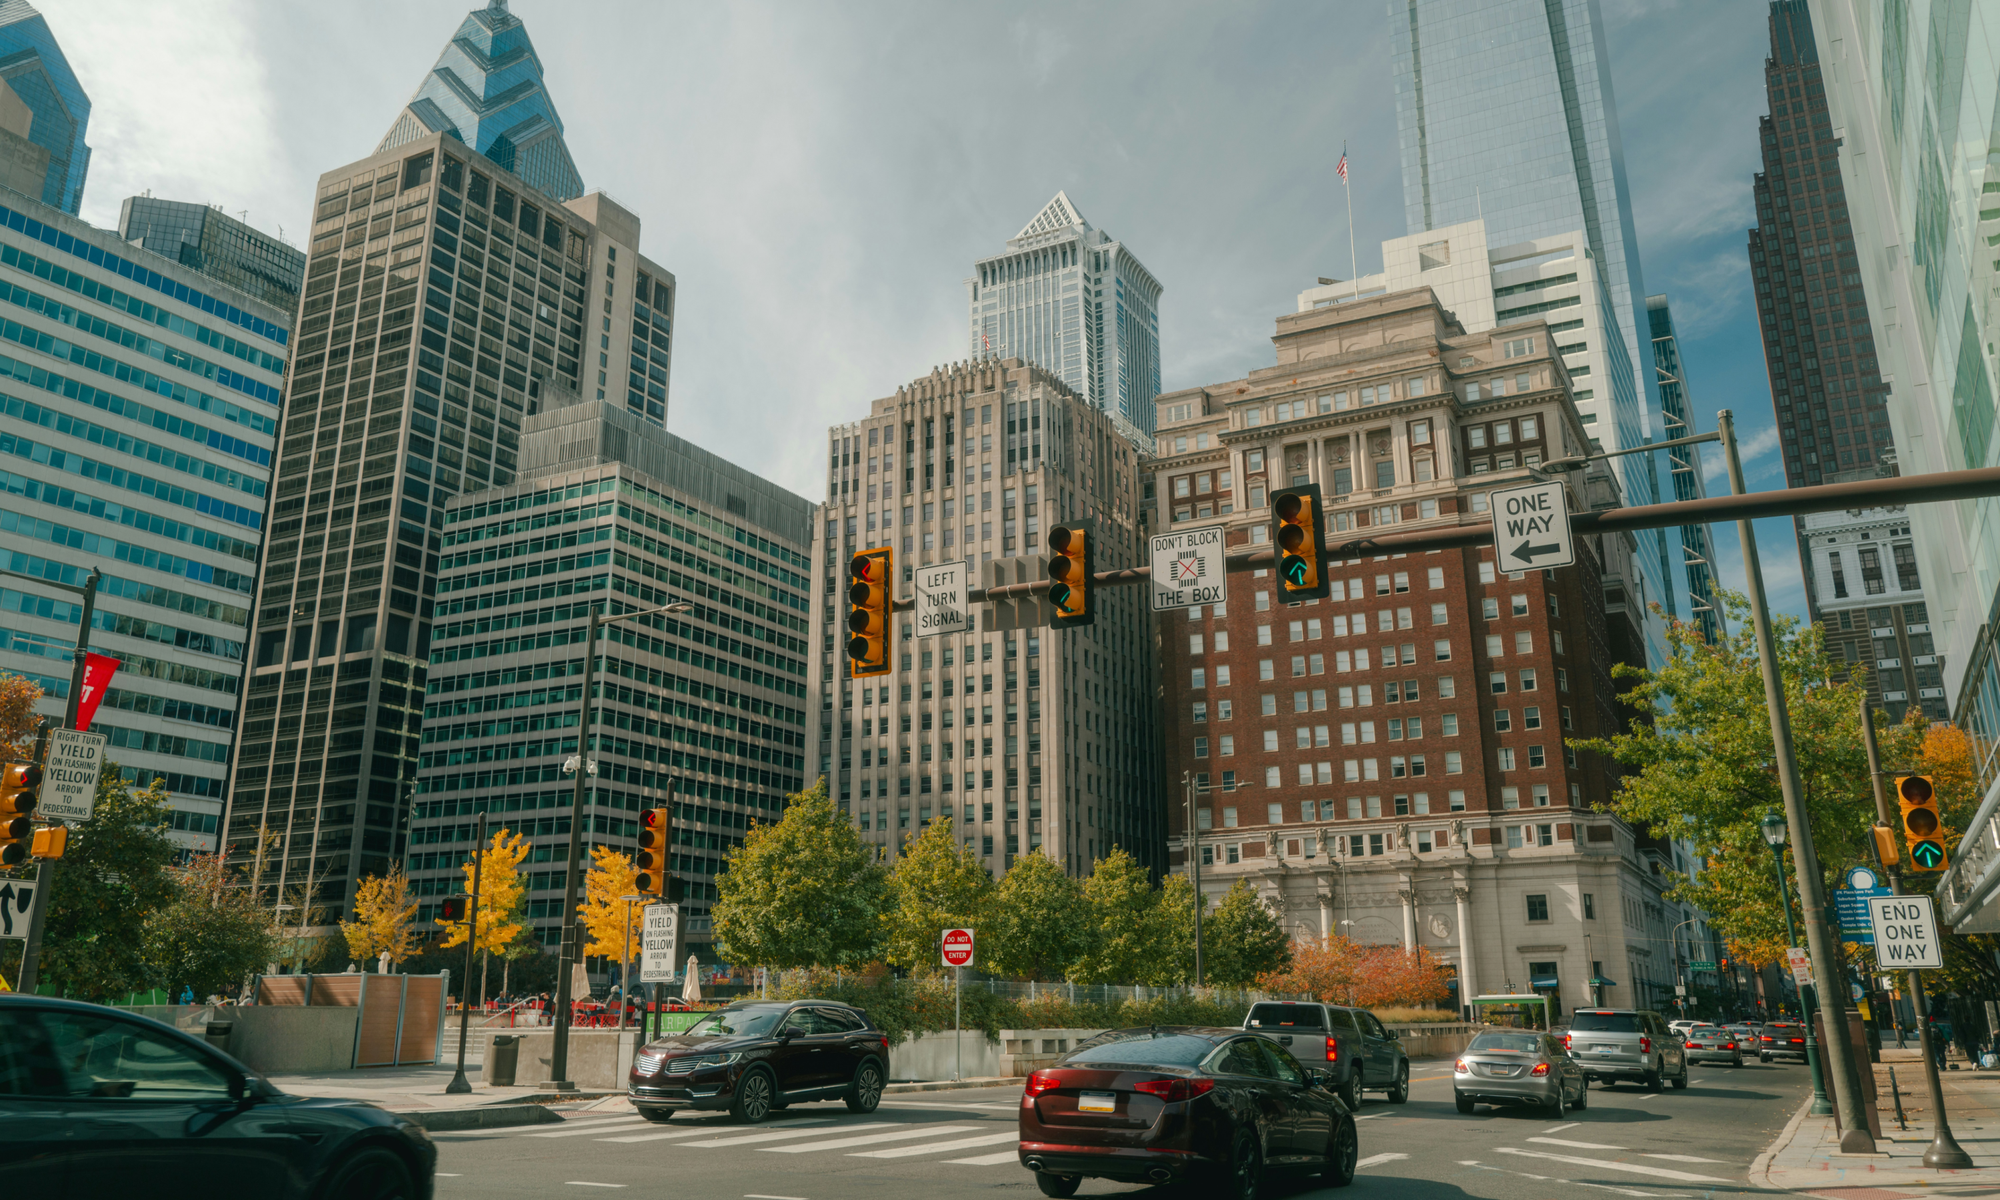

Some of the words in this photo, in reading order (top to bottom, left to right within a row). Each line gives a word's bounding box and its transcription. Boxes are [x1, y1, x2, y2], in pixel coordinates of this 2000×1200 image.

[1506, 492, 1551, 515] ONE
[1506, 514, 1554, 538] WAY
[1155, 536, 1183, 551] DON'T
[1187, 531, 1218, 547] BLOCK
[927, 571, 955, 588] LEFT
[926, 590, 956, 607] TURN
[1158, 590, 1184, 606] THE
[1192, 586, 1220, 602] BOX
[921, 610, 962, 628] SIGNAL
[57, 731, 80, 743] RIGHT
[82, 735, 102, 746] TURN
[60, 743, 95, 759] YIELD
[52, 757, 63, 766] ON
[64, 759, 96, 770] FLASHING
[50, 768, 95, 785] YELLOW
[55, 784, 83, 794] ARROW
[63, 795, 72, 804] TO
[43, 803, 87, 816] PEDESTRIANS
[648, 908, 659, 916] LEFT
[660, 907, 673, 915] TURN
[1881, 904, 1920, 920] END
[649, 917, 672, 928] YIELD
[653, 929, 673, 938] FLASHING
[1885, 924, 1925, 940] ONE
[645, 939, 673, 950] YELLOW
[1887, 944, 1927, 960] WAY
[655, 961, 661, 969] TO
[643, 970, 671, 978] PEDESTRIANS
